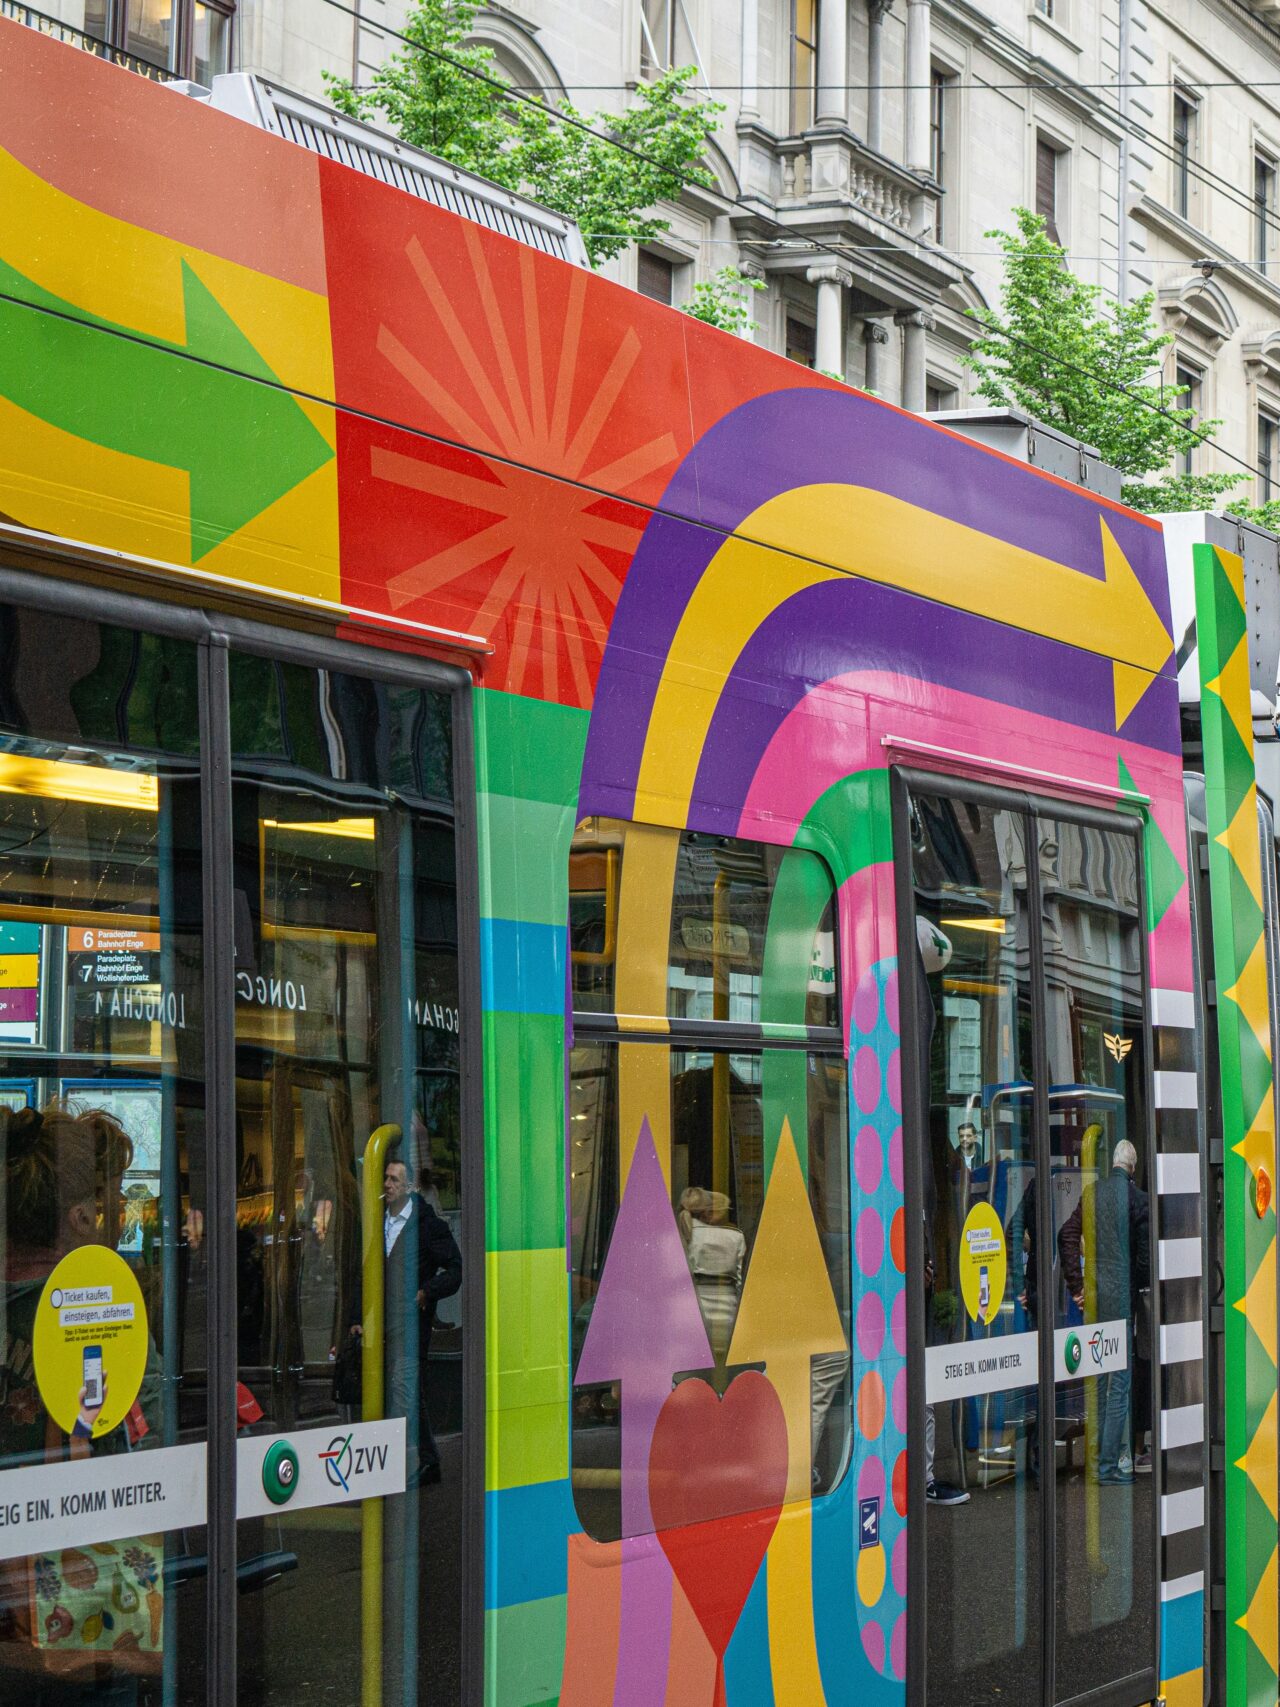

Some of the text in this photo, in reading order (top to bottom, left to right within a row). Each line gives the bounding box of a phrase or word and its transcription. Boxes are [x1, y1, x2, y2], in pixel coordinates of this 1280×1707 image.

[82, 931, 137, 948] 6 Paradeplatz
[97, 940, 144, 949] Bahnhof Enge
[96, 955, 136, 964] Paradeplatz
[82, 964, 93, 982] 7
[126, 964, 144, 973] Enge
[64, 1290, 110, 1302] Ticket kaufen,
[64, 1308, 132, 1322] einsteigen, abfahren.
[1104, 1338, 1120, 1356] ZVV
[944, 1354, 1022, 1380] STEIG EIN. KOMM WEITER.
[355, 1444, 388, 1475] ZVV
[26, 1498, 54, 1523] EIN.
[60, 1490, 107, 1517] KOMM
[112, 1482, 166, 1508] WEITER.
